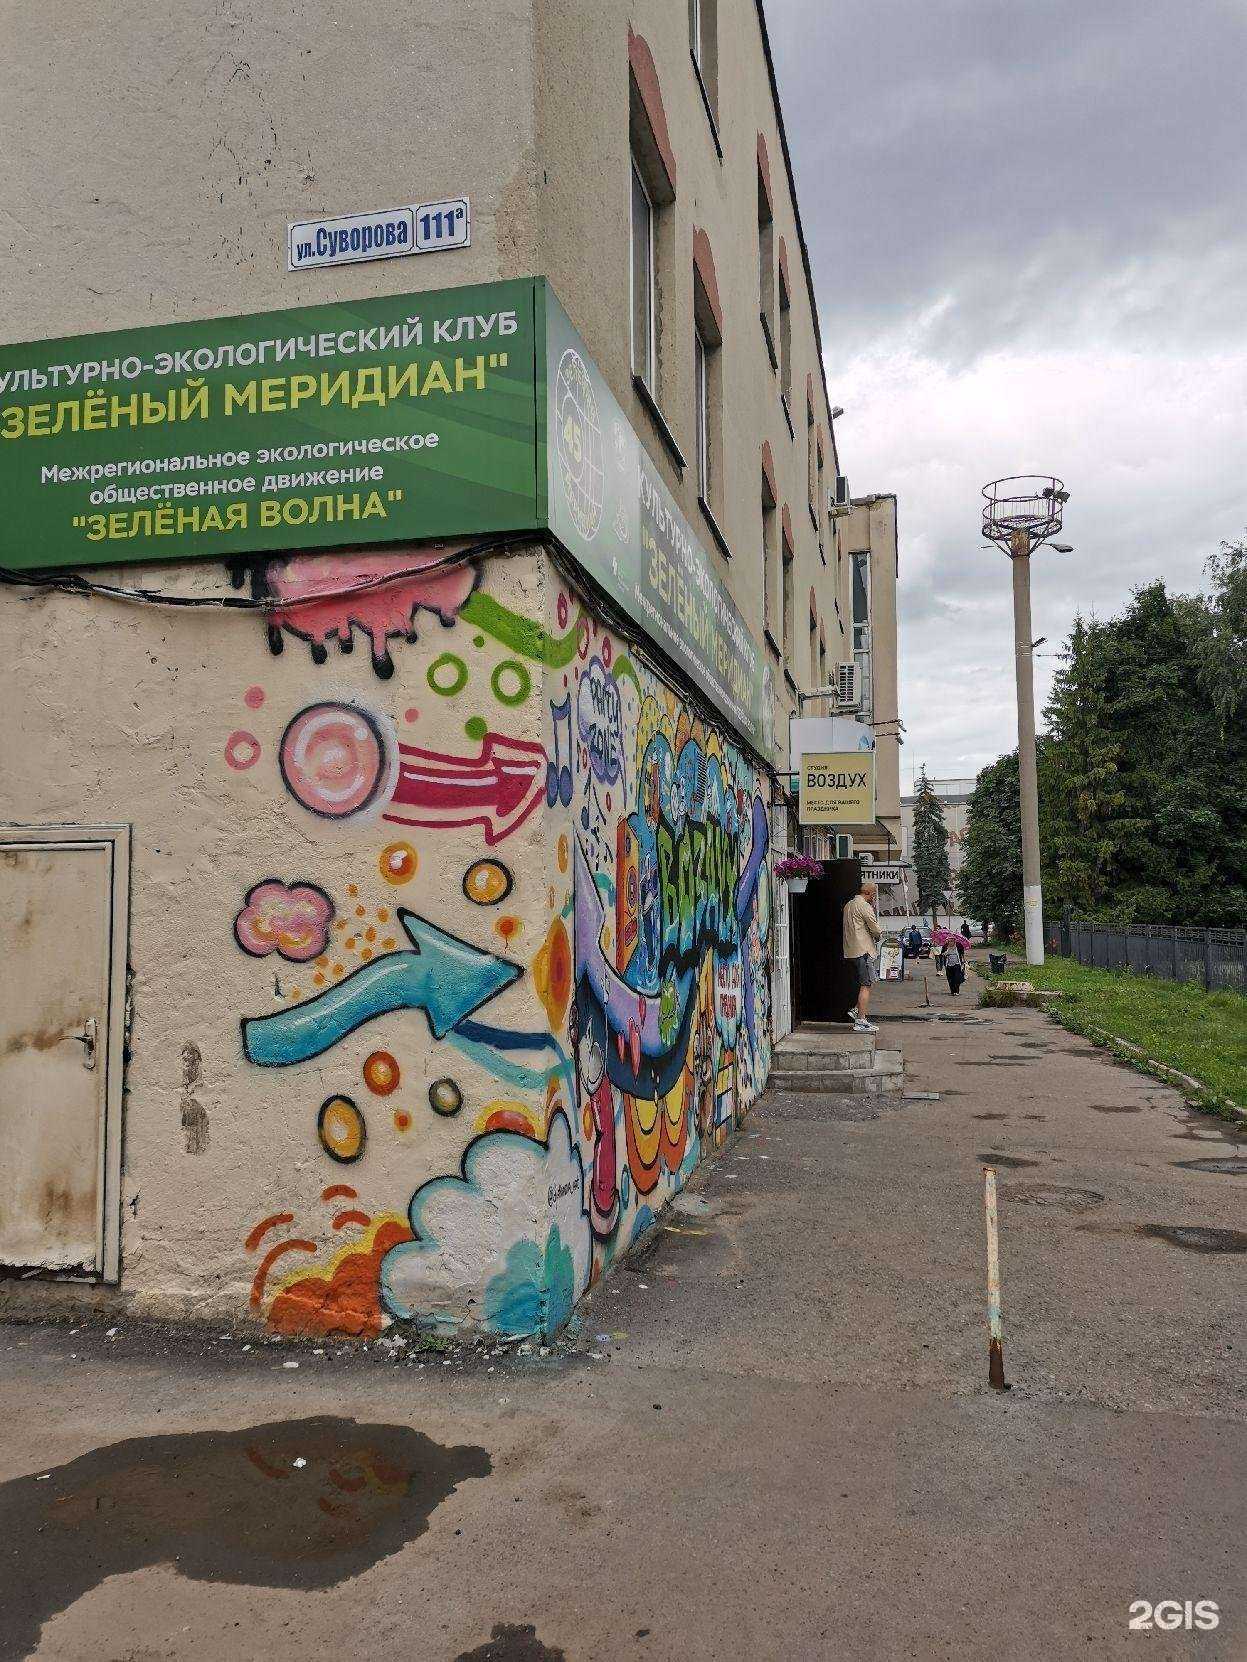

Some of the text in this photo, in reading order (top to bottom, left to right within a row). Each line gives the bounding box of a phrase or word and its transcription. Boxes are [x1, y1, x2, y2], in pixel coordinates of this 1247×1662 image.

[433, 311, 518, 344] КЛУБ
[1, 378, 209, 439] ЗЕЛЁНЫЙ
[224, 352, 508, 416] МЕРИДИАН"
[41, 431, 440, 486] Межрегиональное экологическое
[89, 464, 385, 505] общественное движение
[73, 490, 404, 542] "ЗЕЛЁНАЯ ВОЛНА"
[807, 773, 867, 789] ВОЗДУХ
